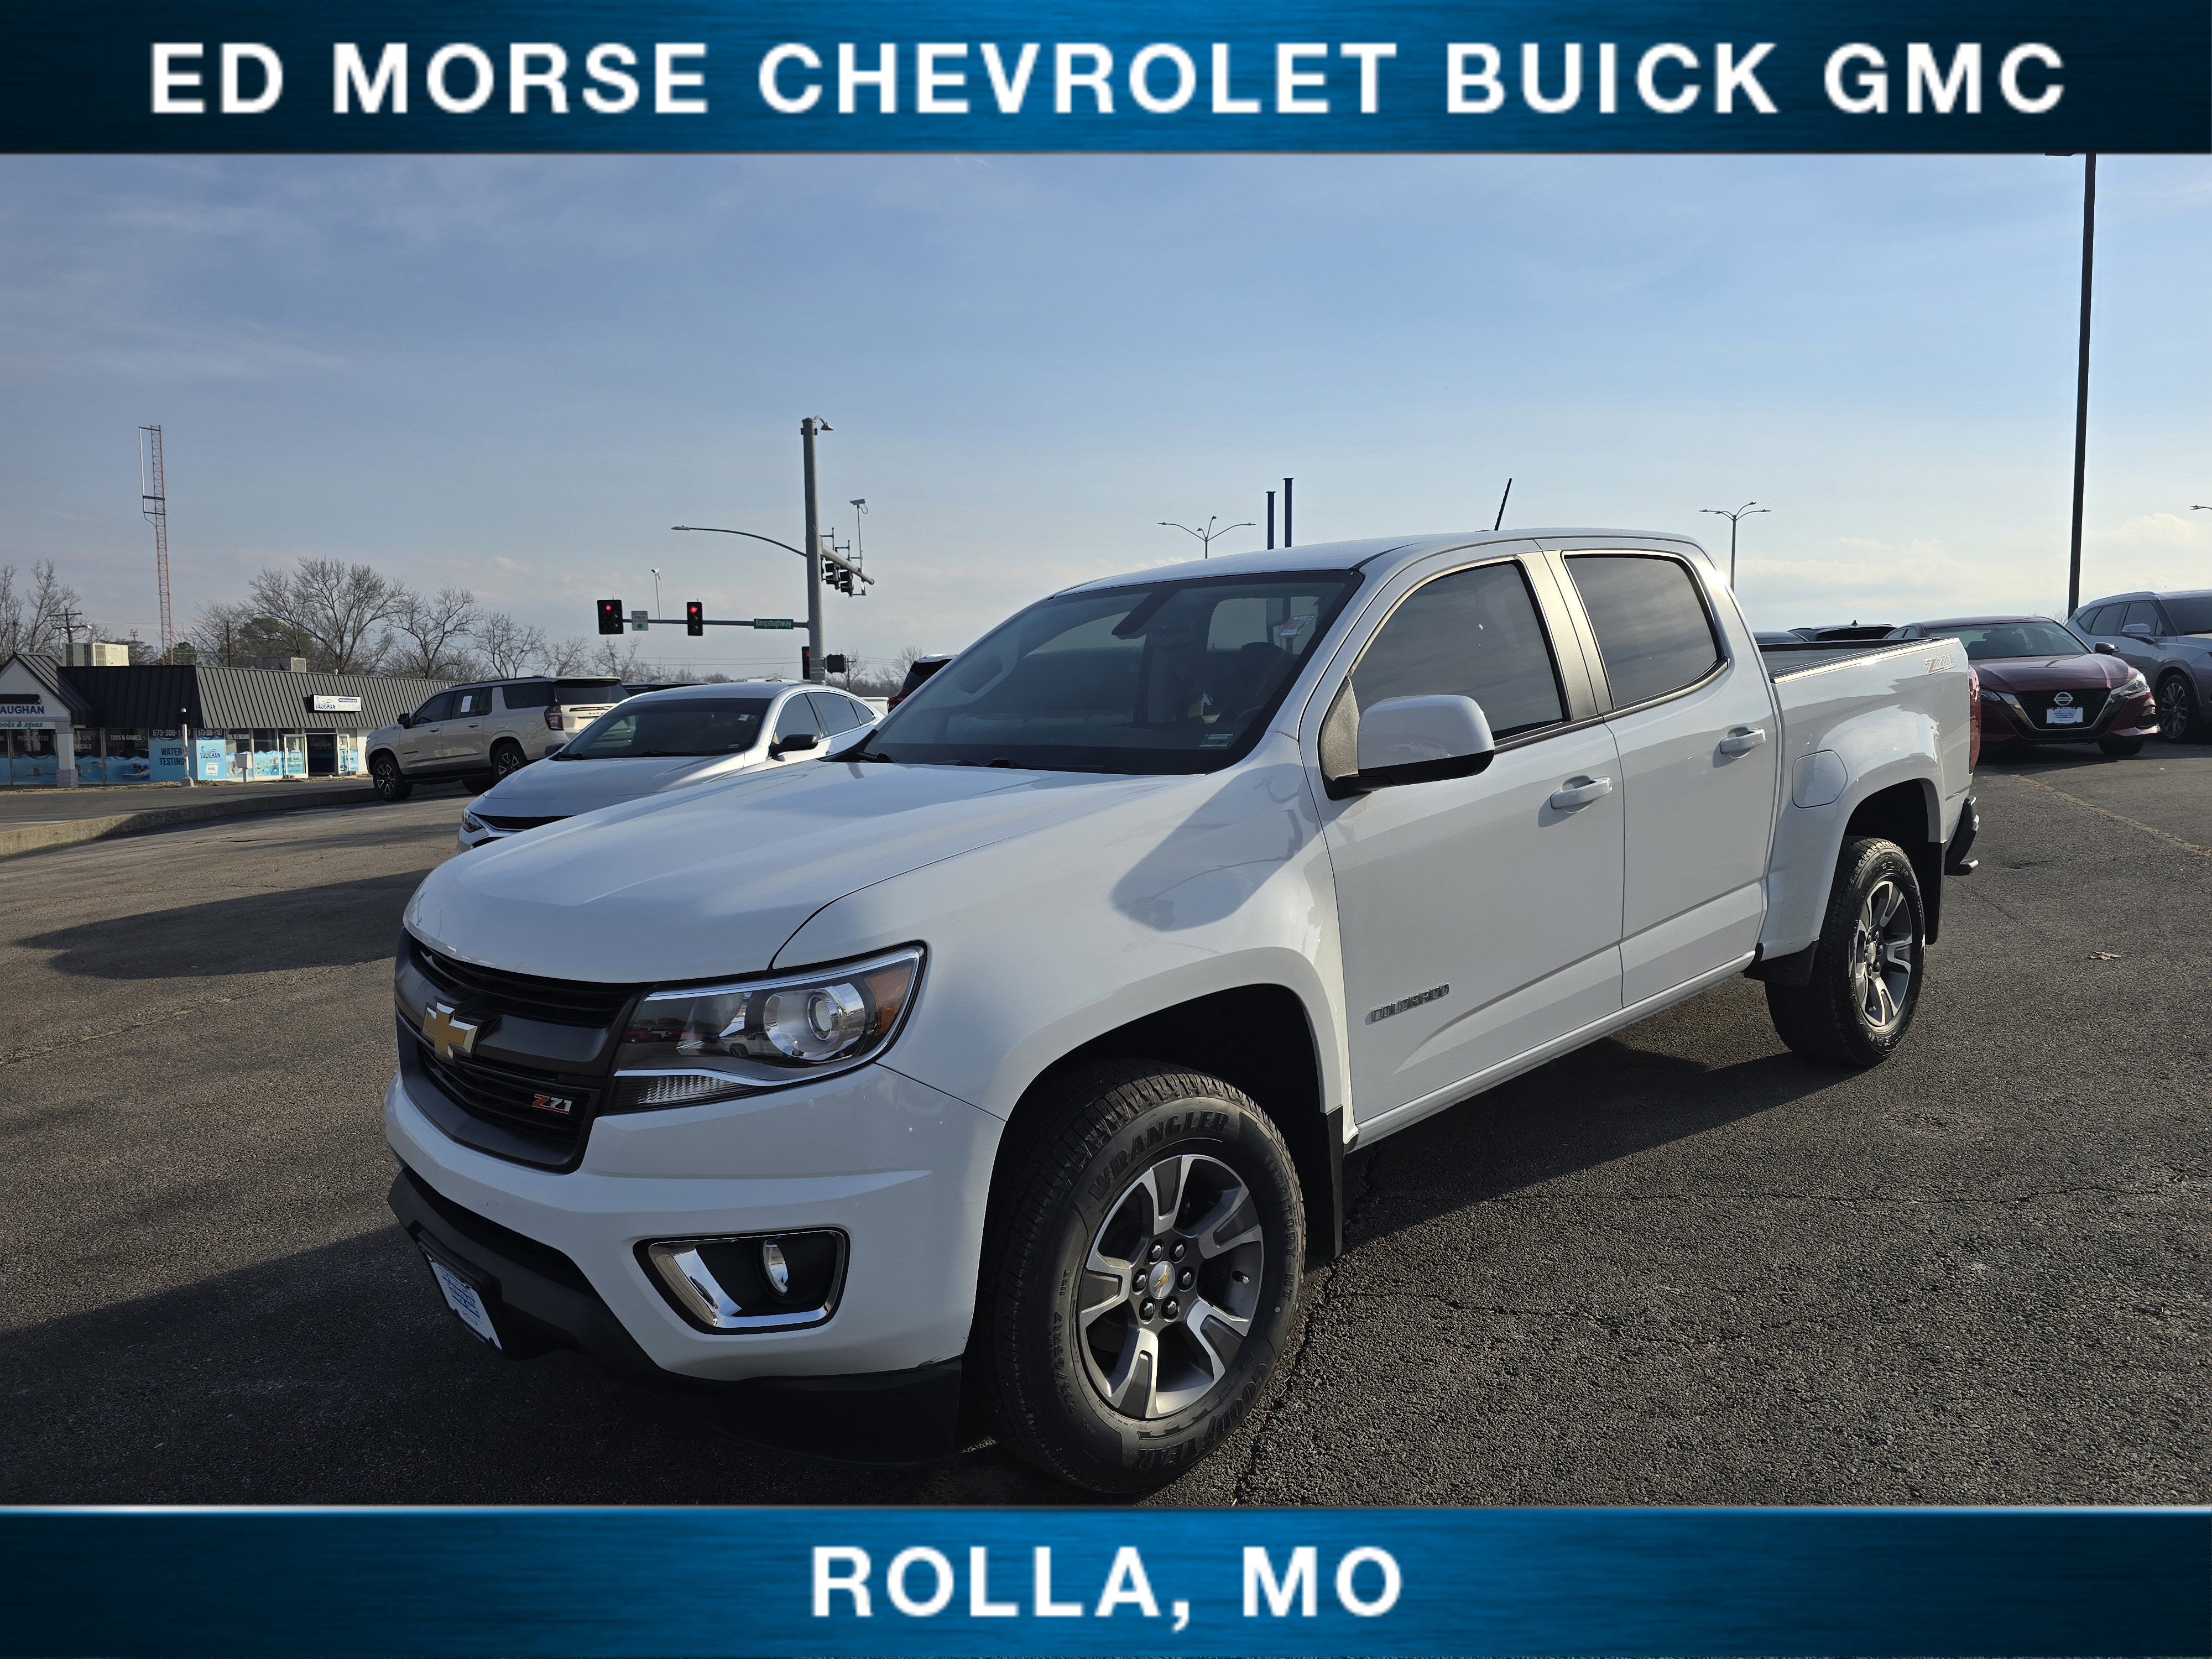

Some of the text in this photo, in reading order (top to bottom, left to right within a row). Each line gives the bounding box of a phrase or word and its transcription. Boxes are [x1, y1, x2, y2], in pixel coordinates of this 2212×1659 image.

[755, 619, 791, 628] Kingshighway
[1924, 653, 1955, 676] Z71
[24, 721, 43, 729] spas
[159, 758, 185, 766] TESTING
[1371, 982, 1450, 1021] COLORADO
[532, 1093, 572, 1114] Z71
[1088, 1109, 1229, 1202] WRANGLER
[1262, 1152, 1297, 1259] TERRITORY
[1133, 1363, 1269, 1471] GOODYEAR
